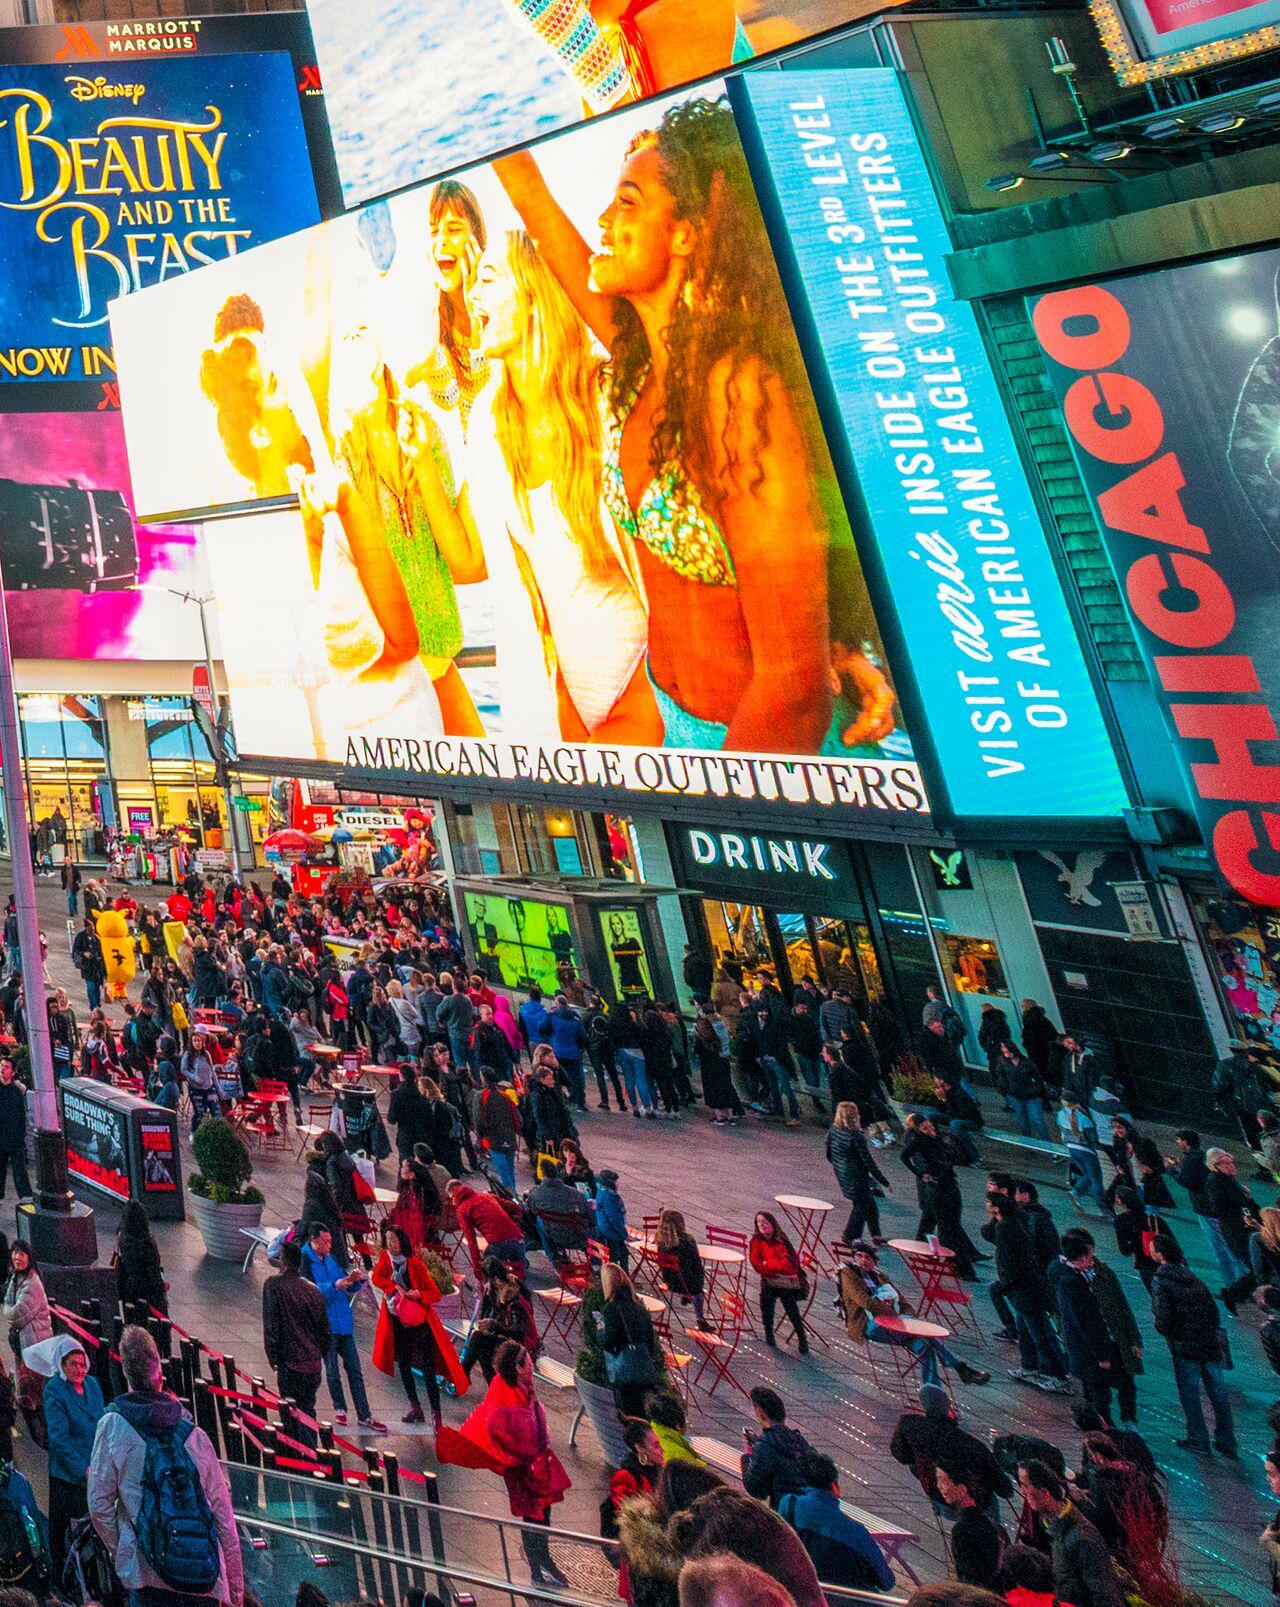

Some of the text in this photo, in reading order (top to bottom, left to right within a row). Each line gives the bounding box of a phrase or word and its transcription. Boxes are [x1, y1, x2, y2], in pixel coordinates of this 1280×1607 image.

[106, 20, 202, 36] MARRIOTT
[108, 35, 195, 52] MARQUIS
[117, 197, 236, 226] AND THE
[789, 94, 1026, 779] VISIT aerie INSIDE ON THE 3RD LEVEL
[849, 132, 1068, 729] OF AMERICAN EAGLE OUTFITTERS
[1034, 285, 1280, 908] CHICAGO
[344, 735, 927, 814] AMERICAN EAGLE OUTFITTERS
[131, 811, 152, 821] FREE
[345, 813, 404, 829] DIESEL
[687, 829, 838, 882] DRINK
[63, 1092, 115, 1126] BROADWAY'S
[64, 1106, 86, 1127] SURE
[66, 1147, 131, 1201] CHICAGO
